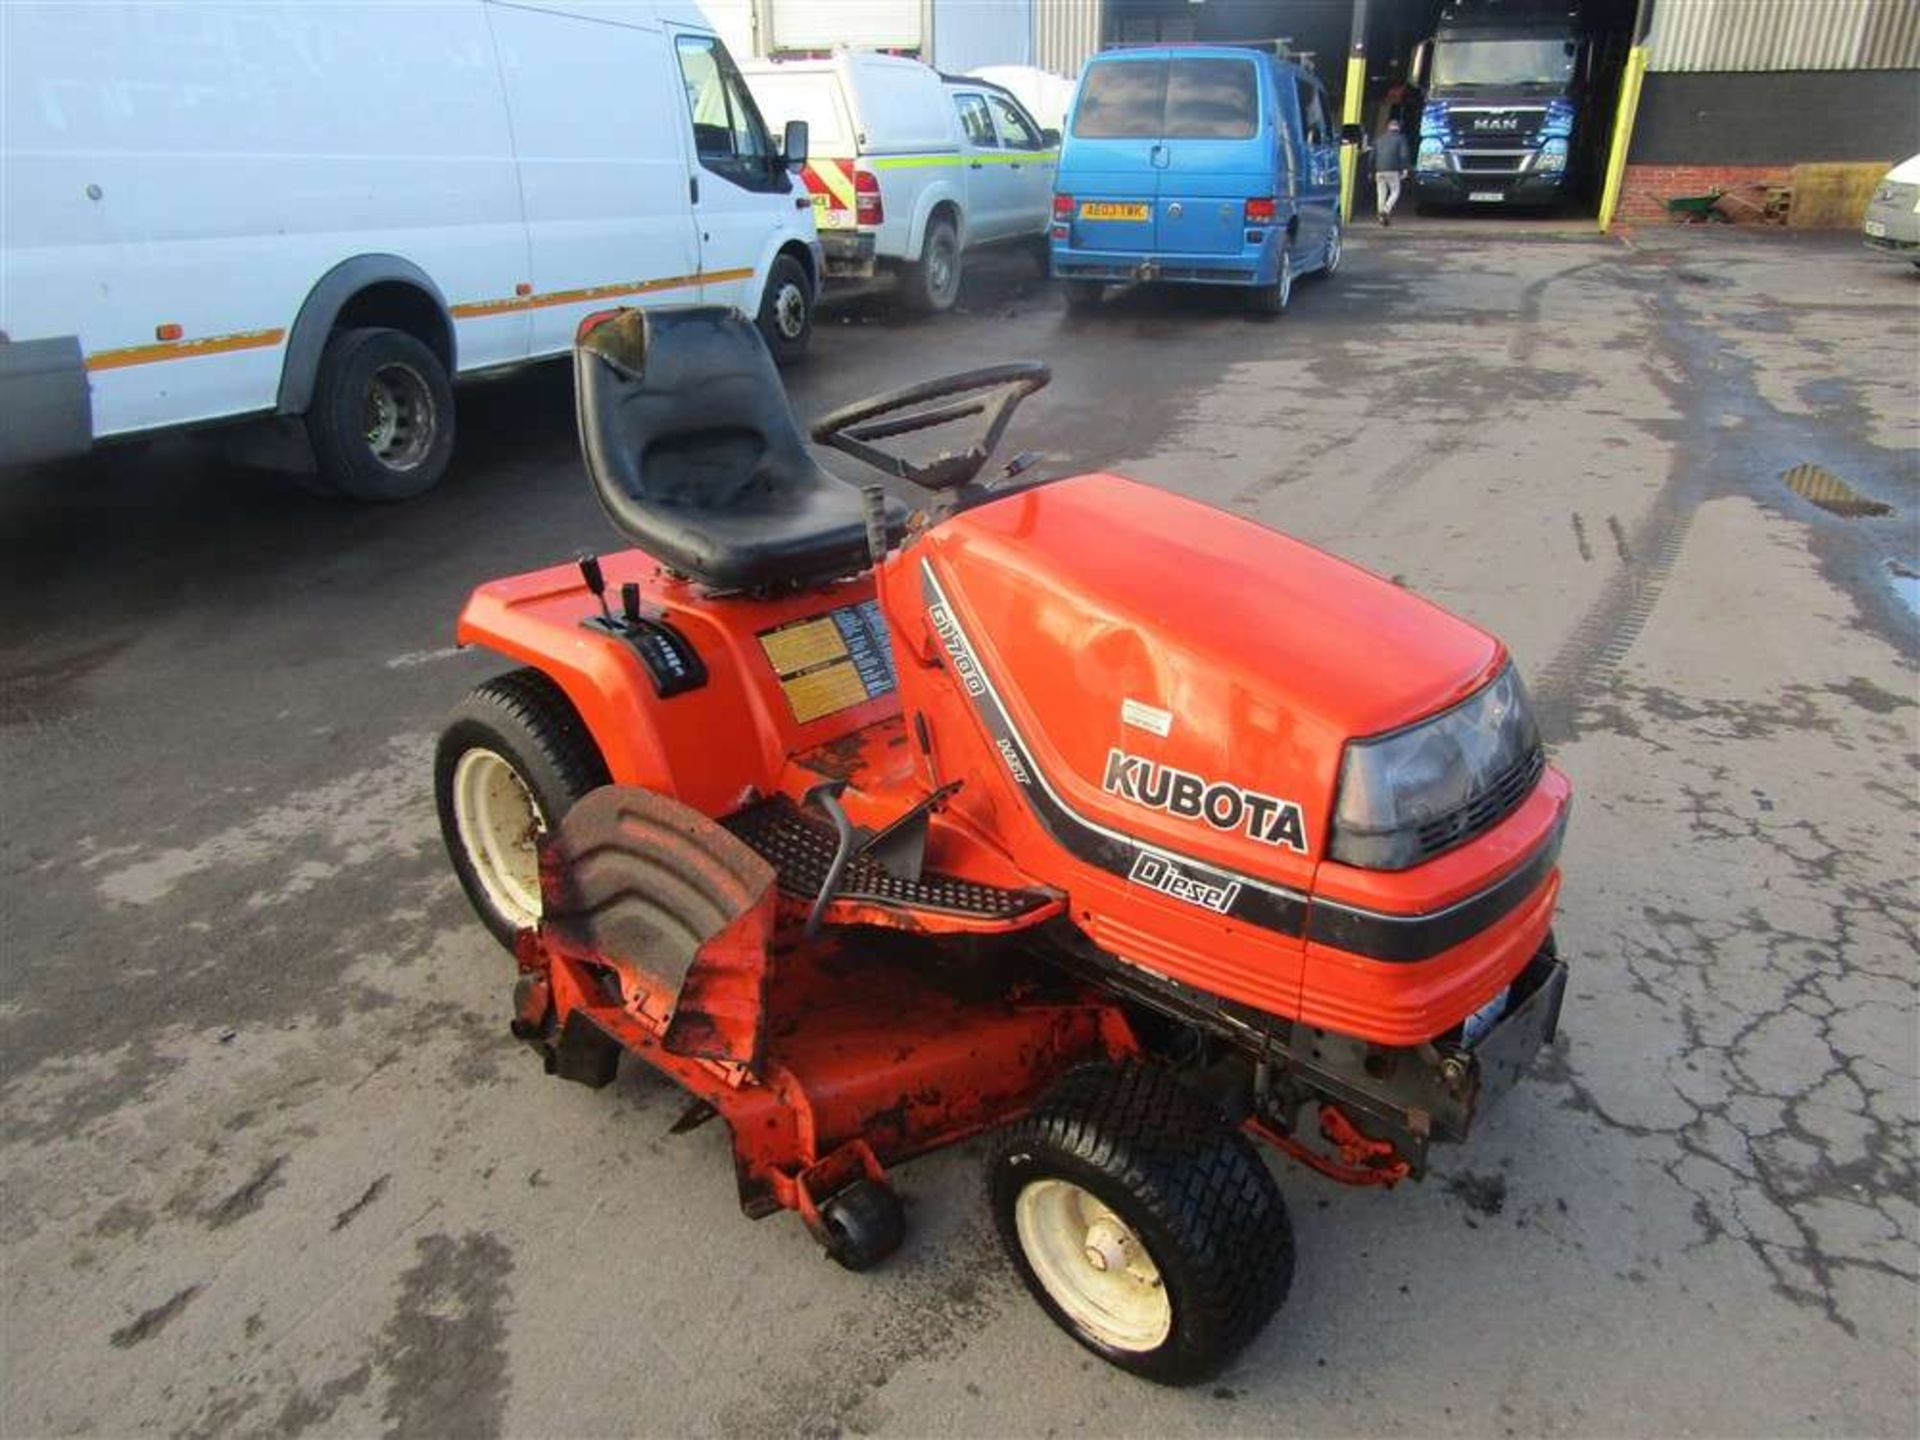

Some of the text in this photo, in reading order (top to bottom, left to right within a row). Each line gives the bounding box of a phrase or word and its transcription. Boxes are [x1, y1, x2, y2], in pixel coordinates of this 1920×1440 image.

[1473, 118, 1518, 130] MAN
[1103, 748, 1308, 854] KUBOTA
[1129, 851, 1241, 914] Diesel
